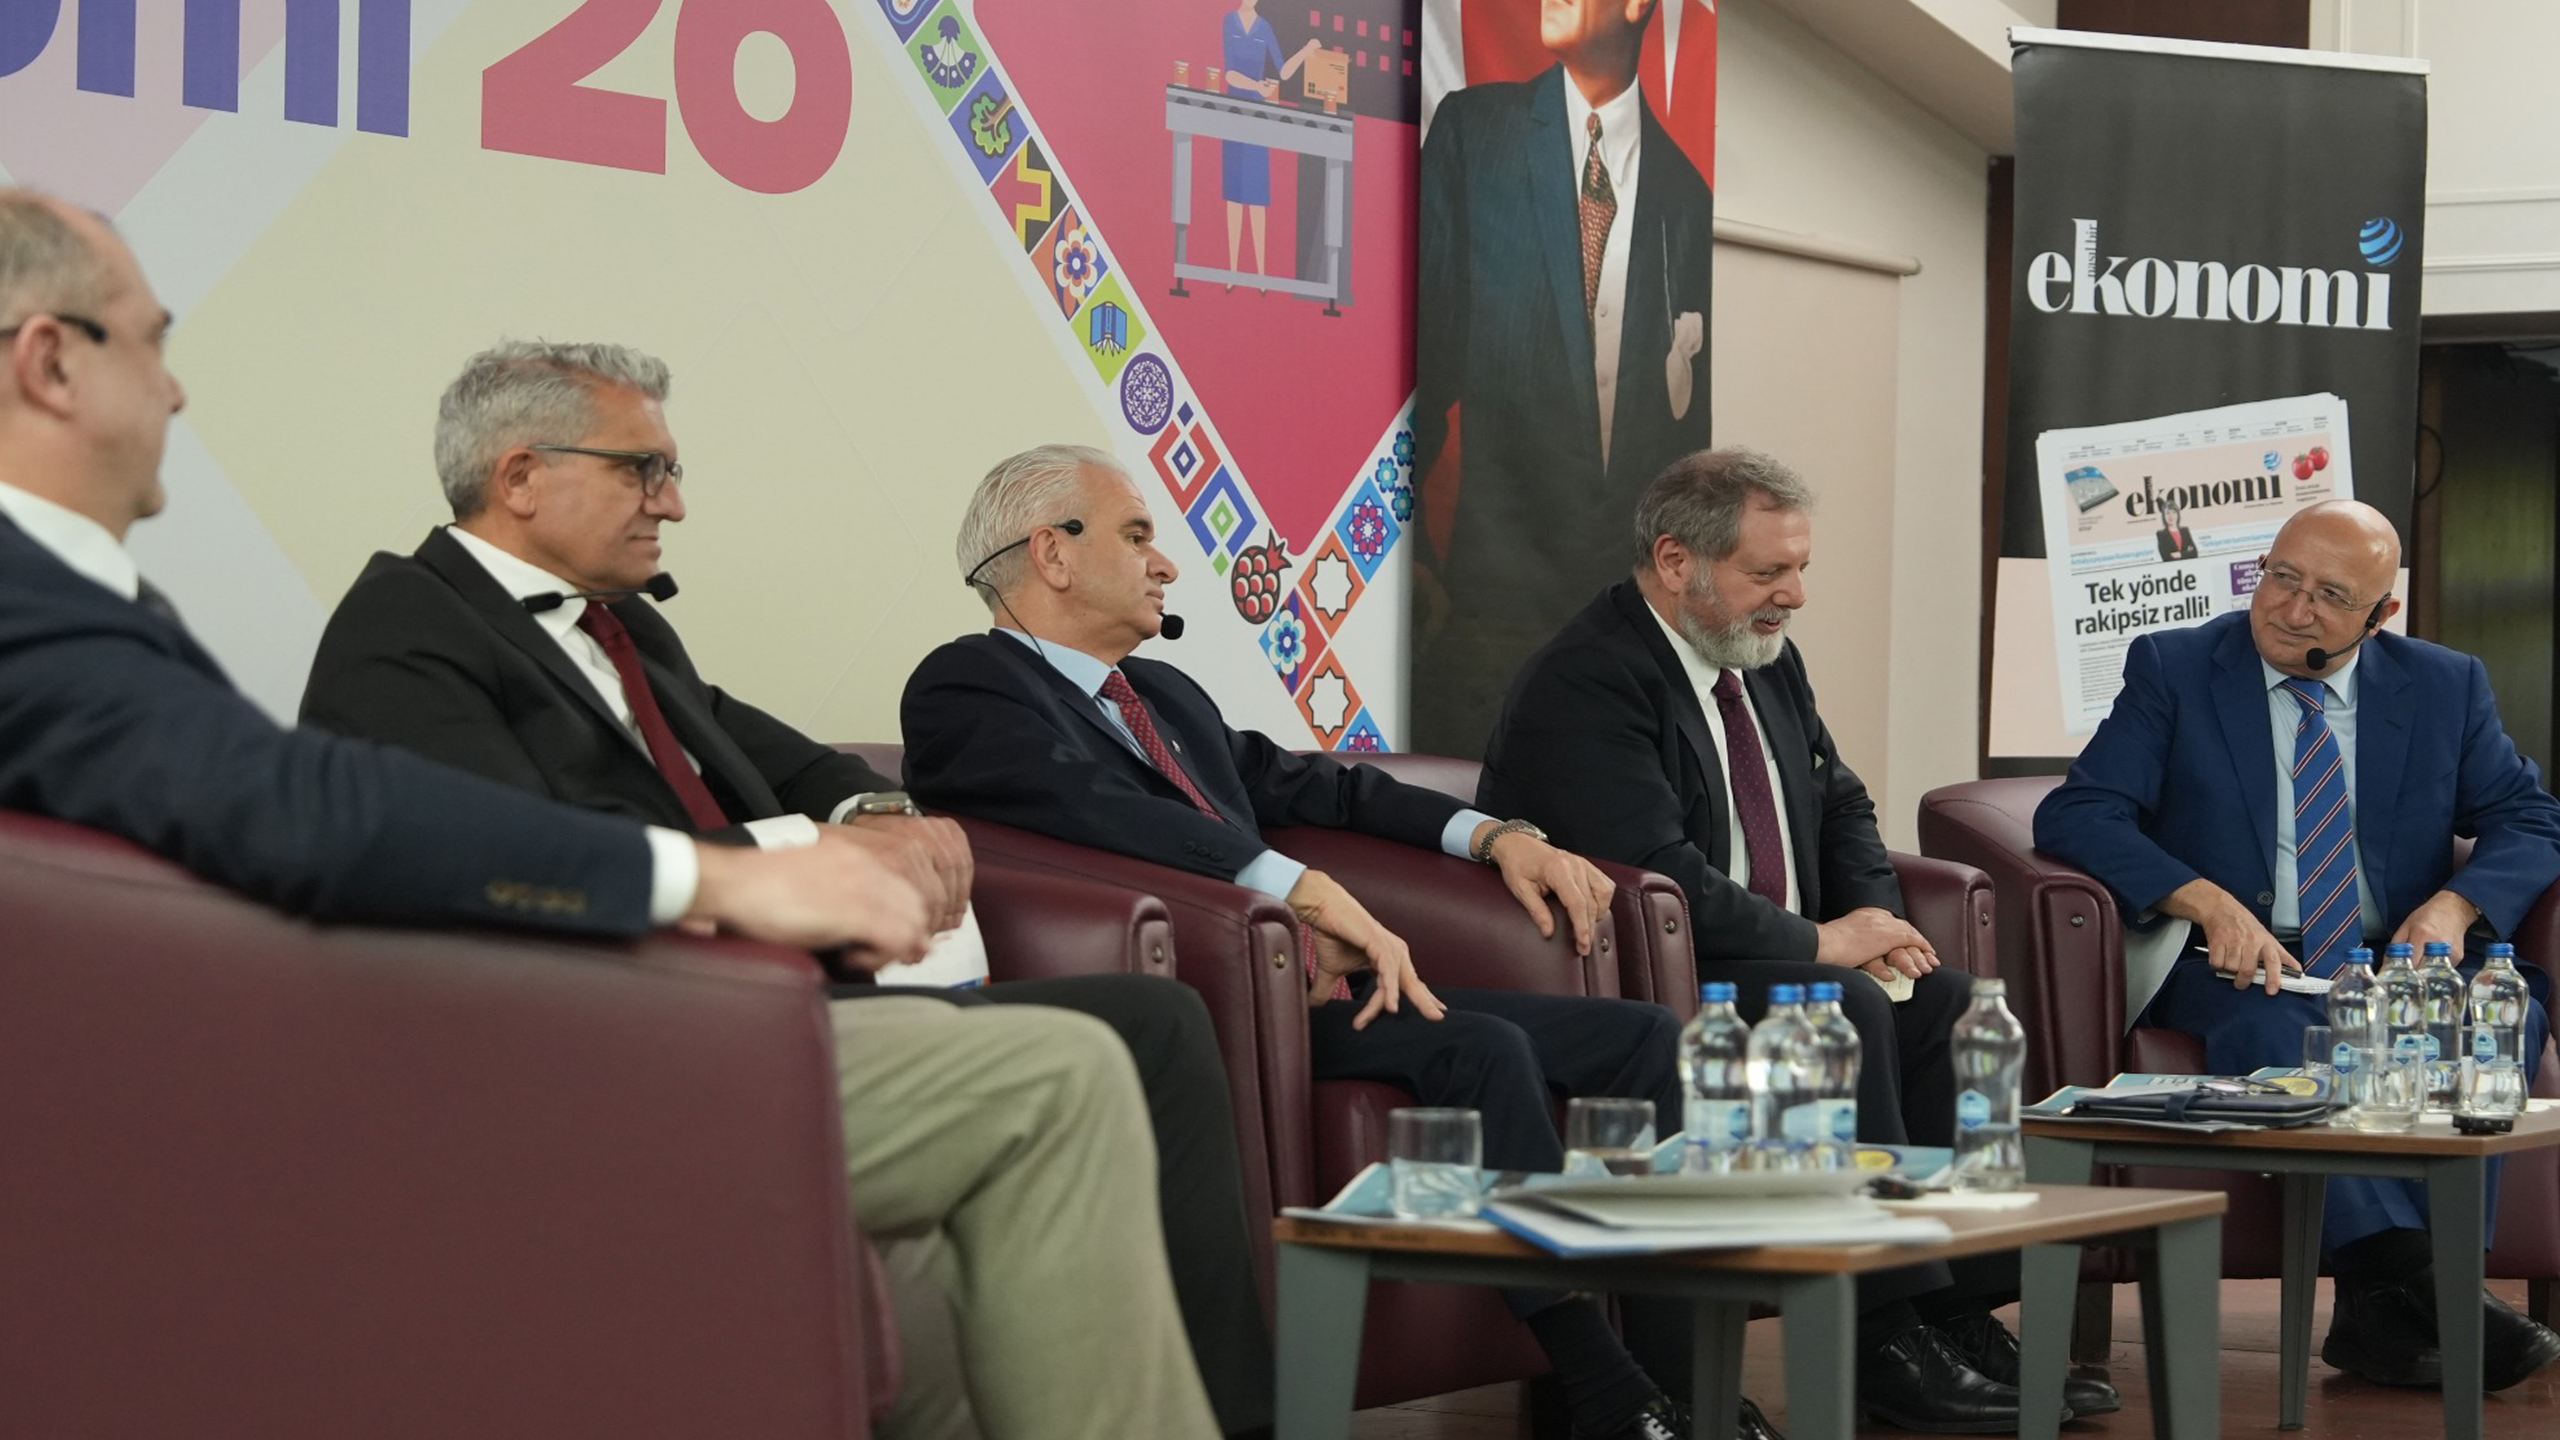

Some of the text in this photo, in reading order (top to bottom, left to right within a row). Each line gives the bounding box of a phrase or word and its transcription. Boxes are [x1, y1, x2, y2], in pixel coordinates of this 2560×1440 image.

[2027, 218, 2393, 330] ekonomi
[2125, 474, 2282, 518] ekonomi
[2085, 578, 2124, 605] Tek
[2128, 569, 2197, 605] yönde
[2075, 604, 2160, 635] rakipsiz
[2163, 596, 2210, 622] ralli!
